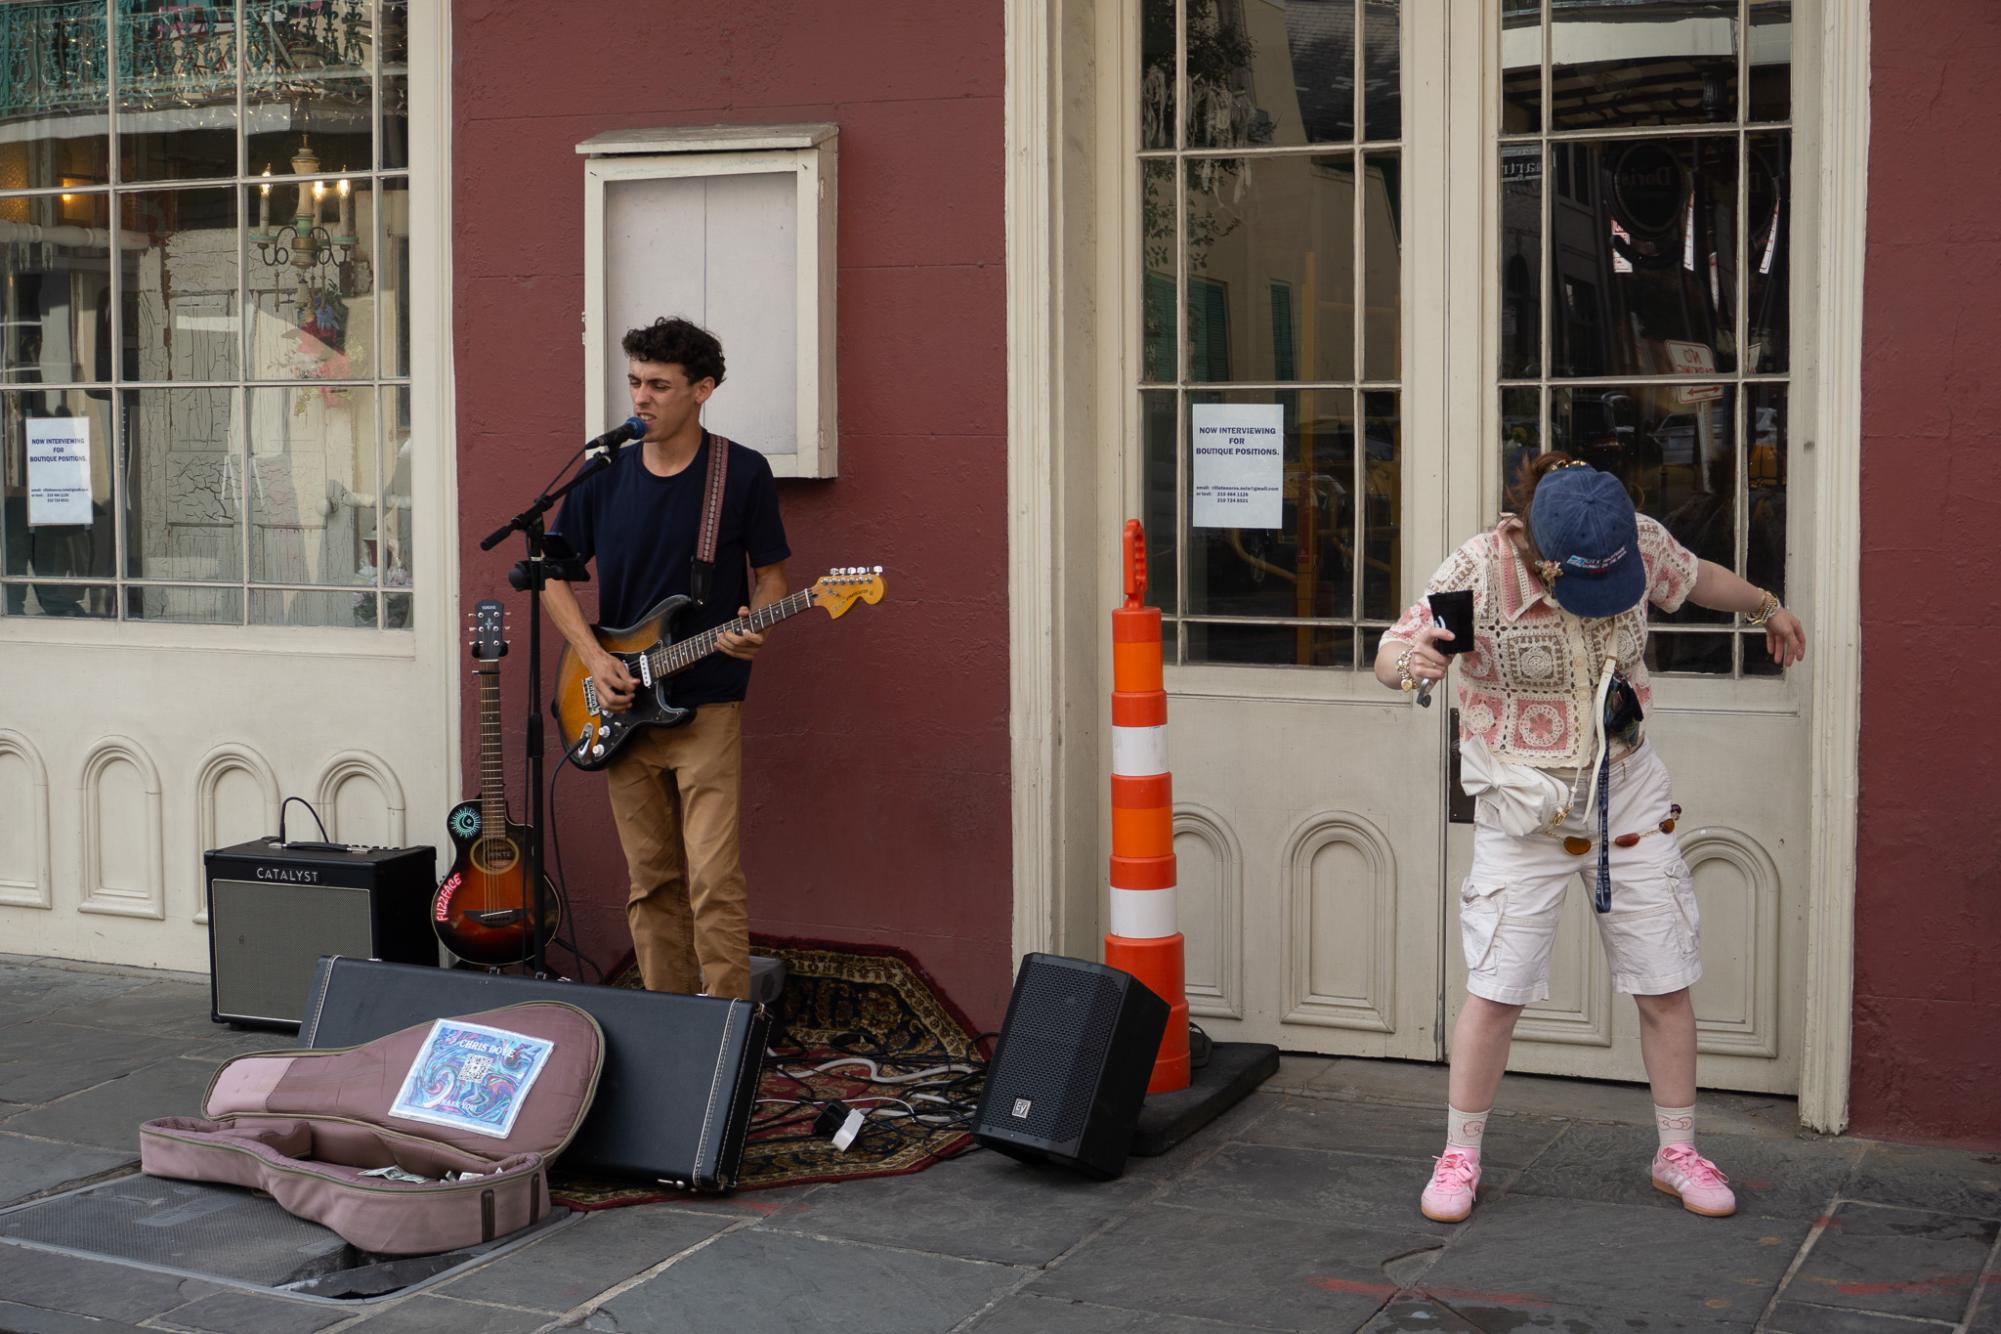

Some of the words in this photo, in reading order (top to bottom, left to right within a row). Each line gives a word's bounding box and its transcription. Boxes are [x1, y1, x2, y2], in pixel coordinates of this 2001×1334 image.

[1219, 427, 1276, 435] INTERVIEWING
[1229, 437, 1245, 445] FOR
[1196, 447, 1234, 455] BOUTIQUE
[1235, 448, 1280, 456] POSITIONS.
[29, 455, 58, 463] BOUTIQUE
[256, 866, 319, 883] CATALYST
[435, 872, 463, 922] FUZZFACE
[459, 1038, 489, 1053] CHRIS
